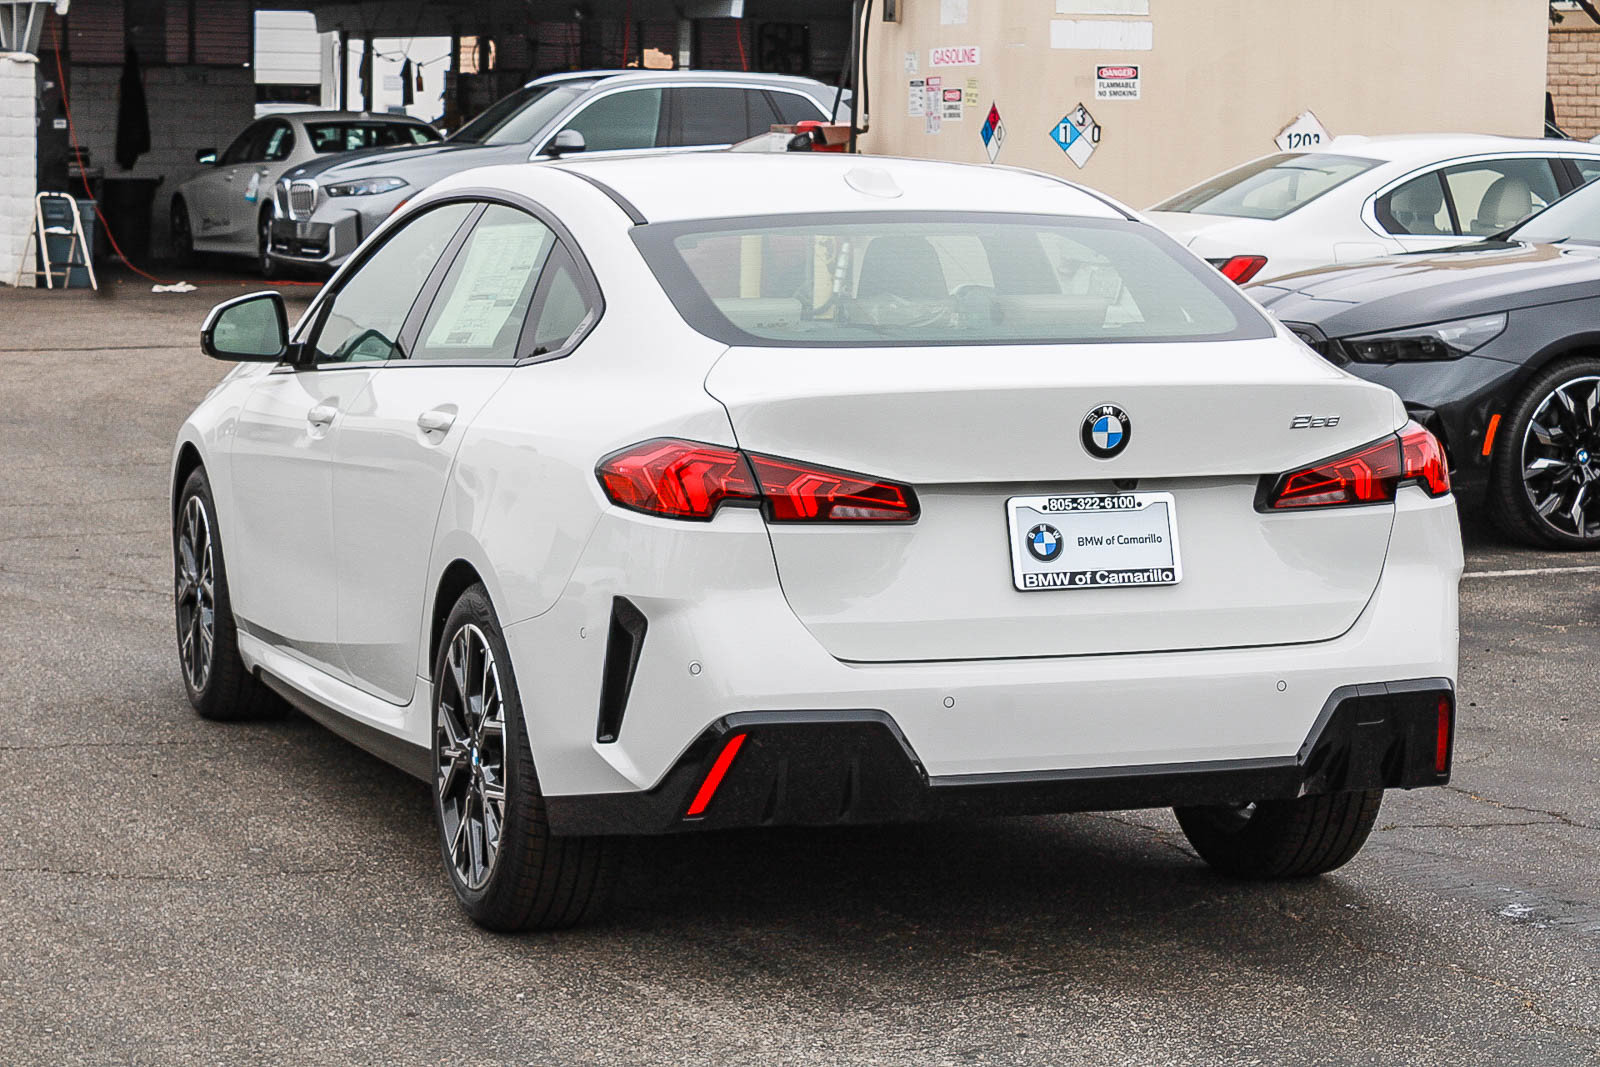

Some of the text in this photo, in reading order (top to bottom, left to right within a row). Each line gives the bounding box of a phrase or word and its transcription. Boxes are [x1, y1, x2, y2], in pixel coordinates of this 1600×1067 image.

[933, 48, 977, 65] GASOLINE
[1102, 68, 1133, 77] DANGER
[1098, 81, 1136, 89] FLAMMABLE
[1076, 107, 1086, 126] 3
[1092, 125, 1101, 143] 0
[1290, 414, 1340, 429] 228
[1049, 497, 1134, 511] 805-322-6100
[1078, 533, 1163, 547] BMW of Camarillo
[1025, 569, 1173, 588] BMW of Camarillo
